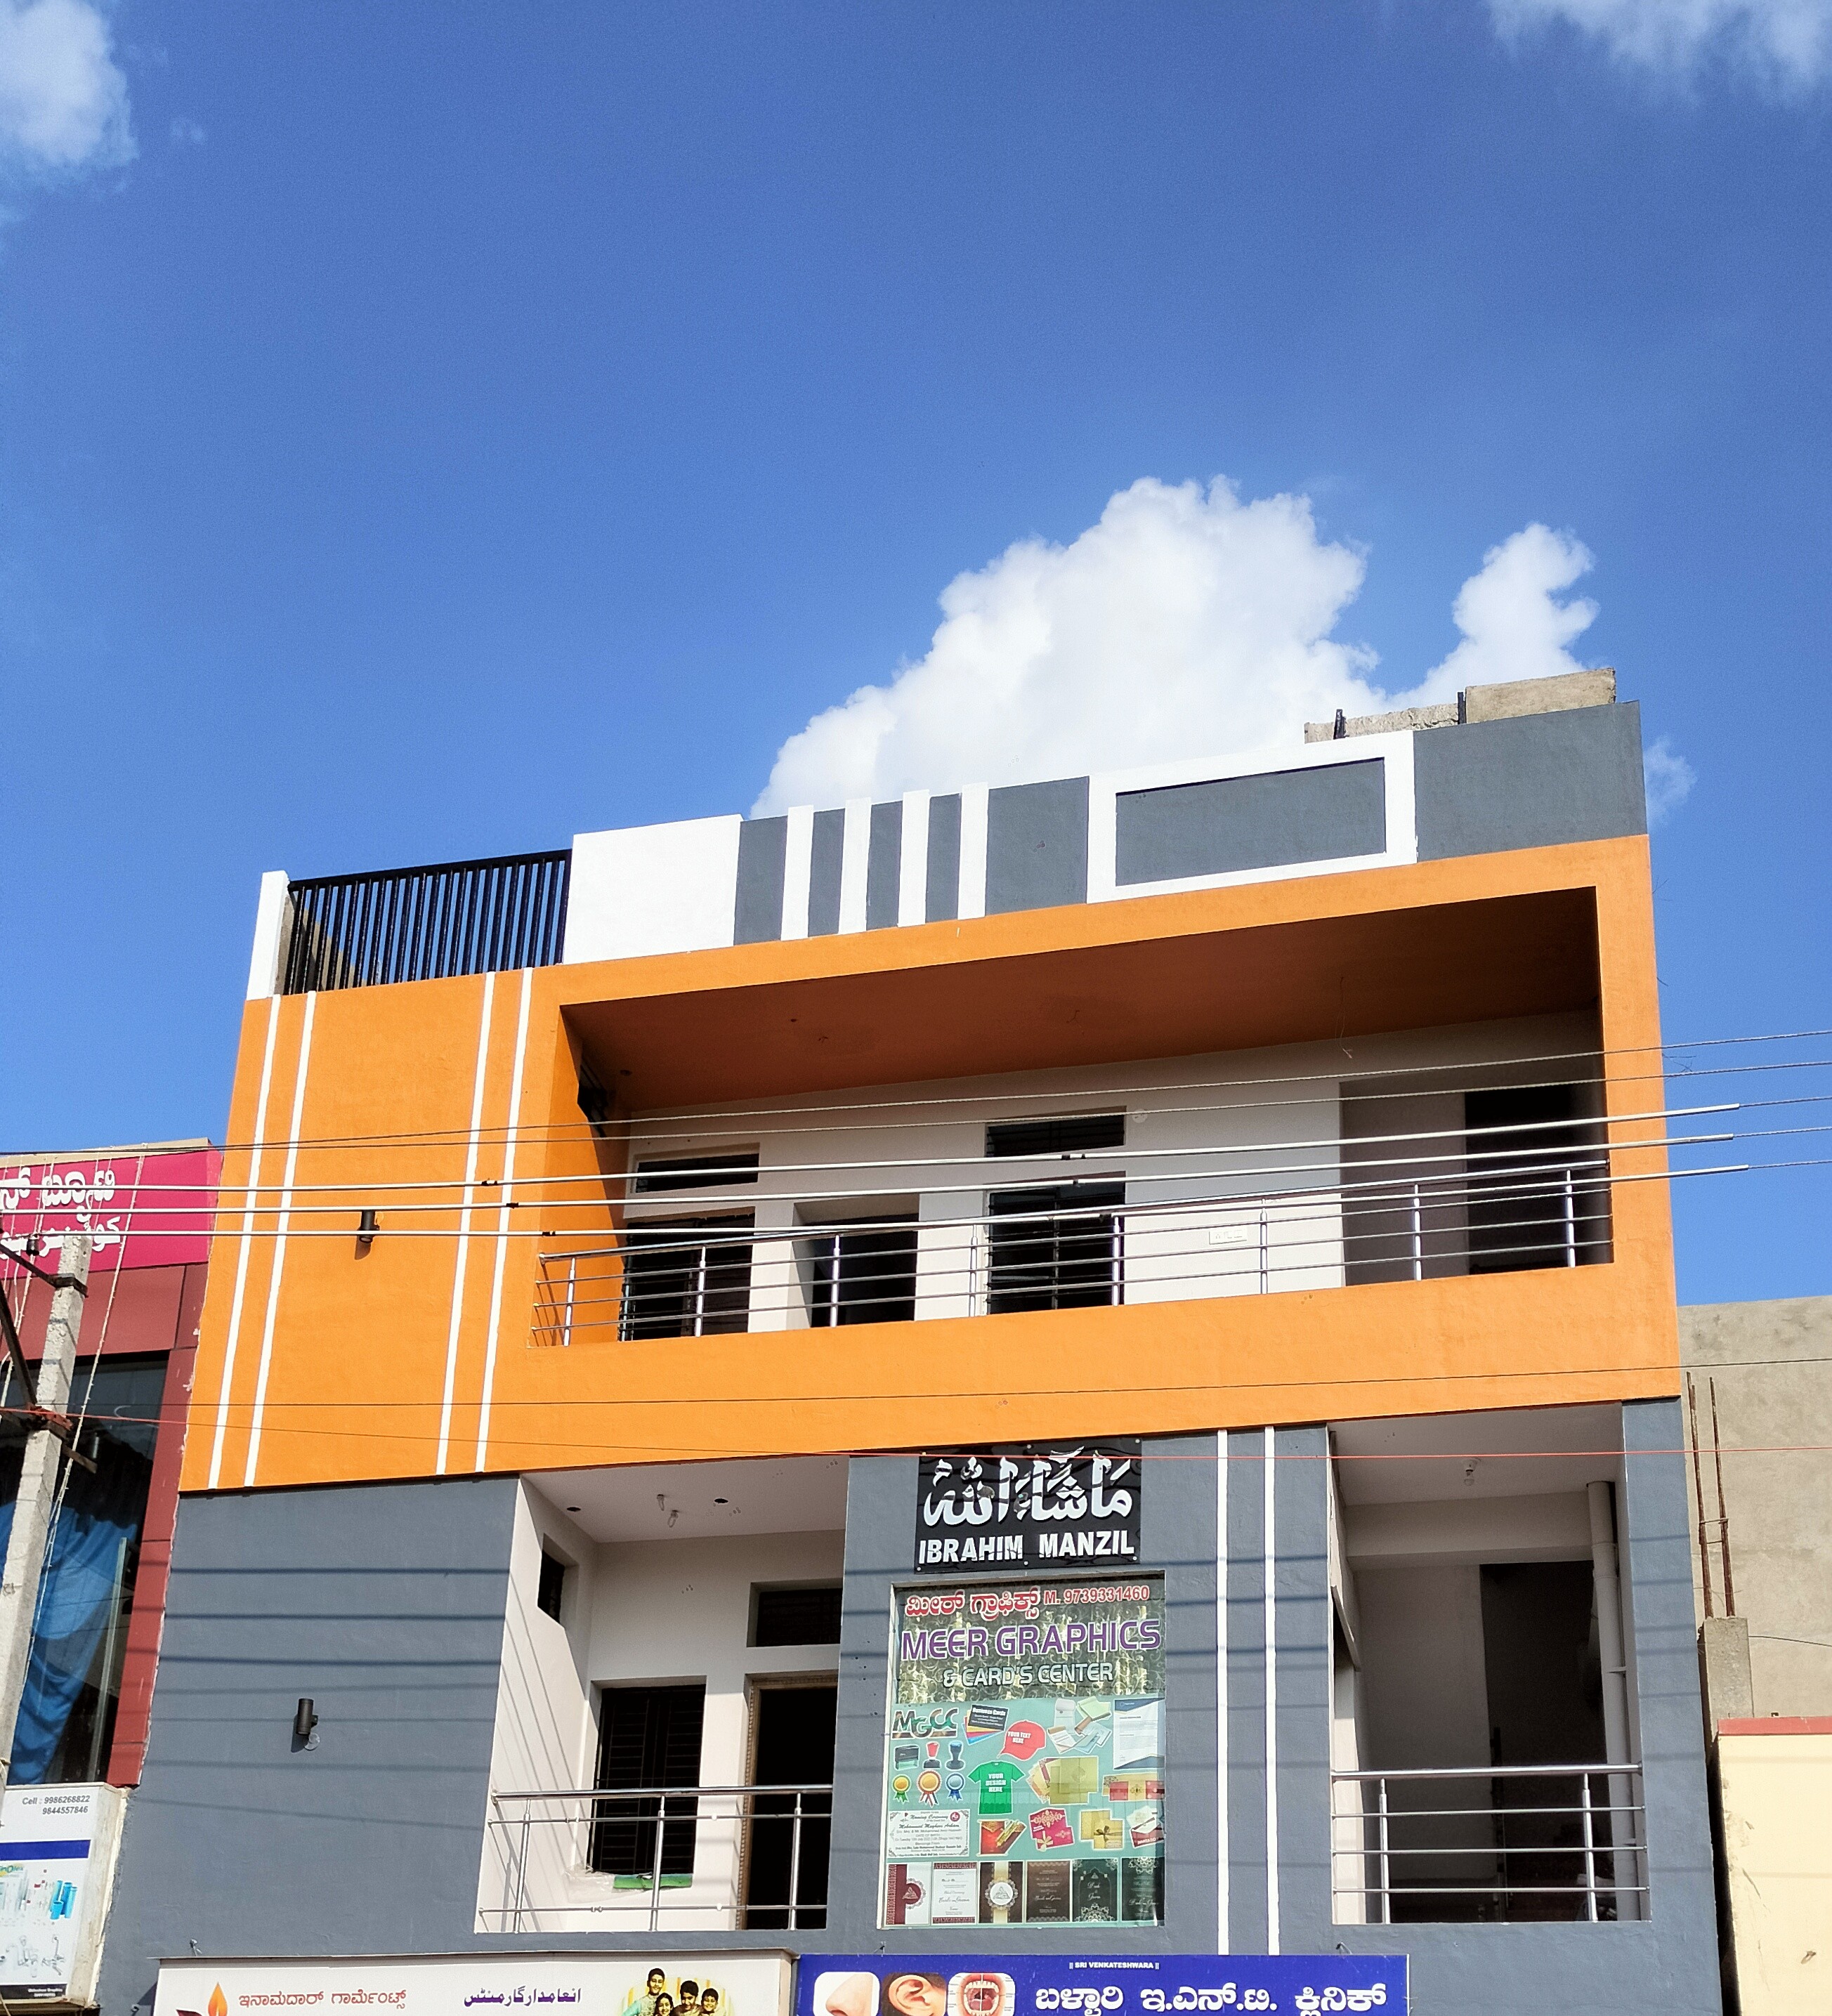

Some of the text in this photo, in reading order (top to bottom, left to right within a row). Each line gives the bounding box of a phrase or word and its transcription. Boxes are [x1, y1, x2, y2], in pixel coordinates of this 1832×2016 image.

[918, 1530, 1134, 1564] IBRAHIM MANZIL
[905, 1585, 1150, 1621] ಮೀರ್ ಗ್ರಾಫಿಕ್ಸ್ M. 9739331460
[901, 1618, 1161, 1661] MEER GRAPHICS
[943, 1662, 1113, 1687] & CARD'S CENTER
[42, 1806, 89, 1814] 9844557846
[44, 1795, 91, 1804] 9986268822
[239, 1989, 407, 2009] ಇನಾಮದಾರ್ ಗಾರ್ಮೆಂಟ್ಸ್
